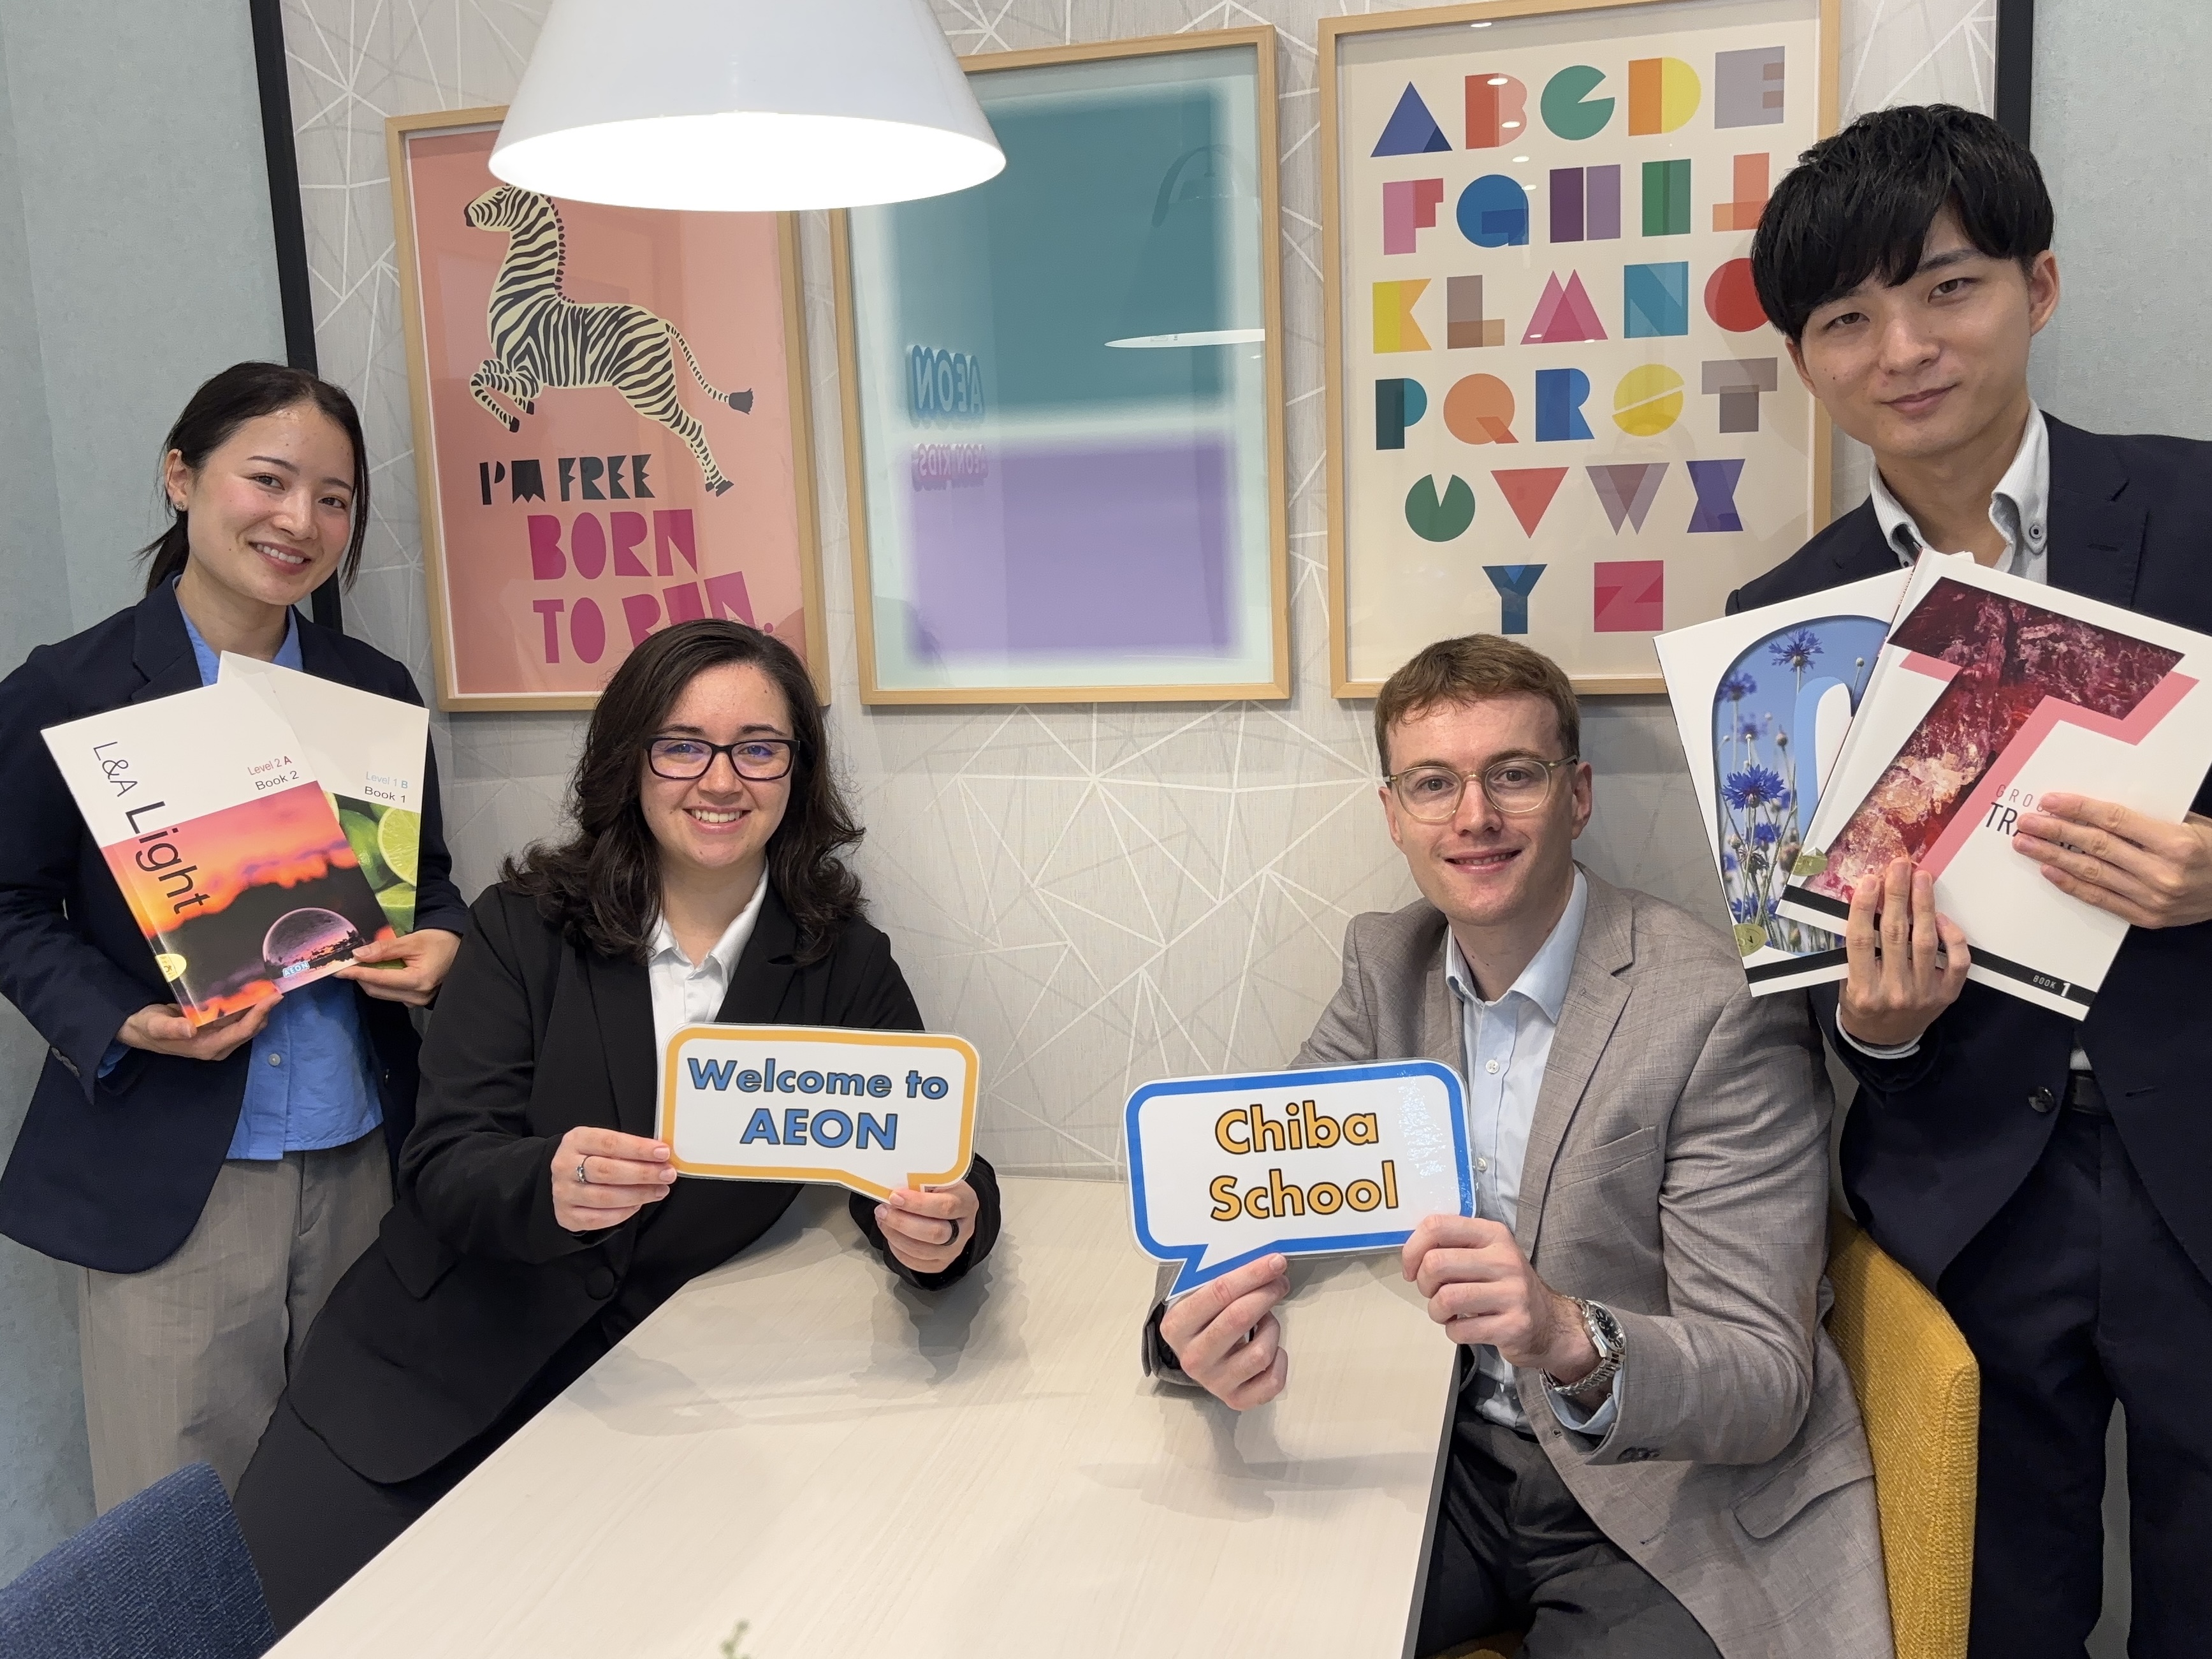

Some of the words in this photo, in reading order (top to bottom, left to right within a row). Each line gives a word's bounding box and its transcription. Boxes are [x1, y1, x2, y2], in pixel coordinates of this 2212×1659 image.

[558, 454, 655, 502] FREE
[527, 509, 698, 580] BORN
[532, 597, 606, 664] TO
[247, 760, 273, 776] Level
[274, 758, 282, 768] 2
[284, 756, 293, 765] A
[255, 773, 288, 791] Book
[289, 770, 300, 780] 2
[365, 771, 390, 785] Level
[393, 778, 398, 787] 1
[401, 780, 408, 789] B
[364, 786, 396, 801] Book
[400, 795, 406, 803] 1
[1996, 784, 2054, 817] GRO
[93, 741, 138, 797] L&A
[125, 801, 210, 915] Light
[284, 961, 309, 976] AEON
[2033, 975, 2056, 989] BOOK
[2061, 983, 2071, 997] 1
[687, 1057, 892, 1099] Welcome
[905, 1070, 949, 1100] to
[739, 1108, 899, 1150] AEON
[1215, 1100, 1379, 1155] Chiba
[1209, 1160, 1399, 1222] School
